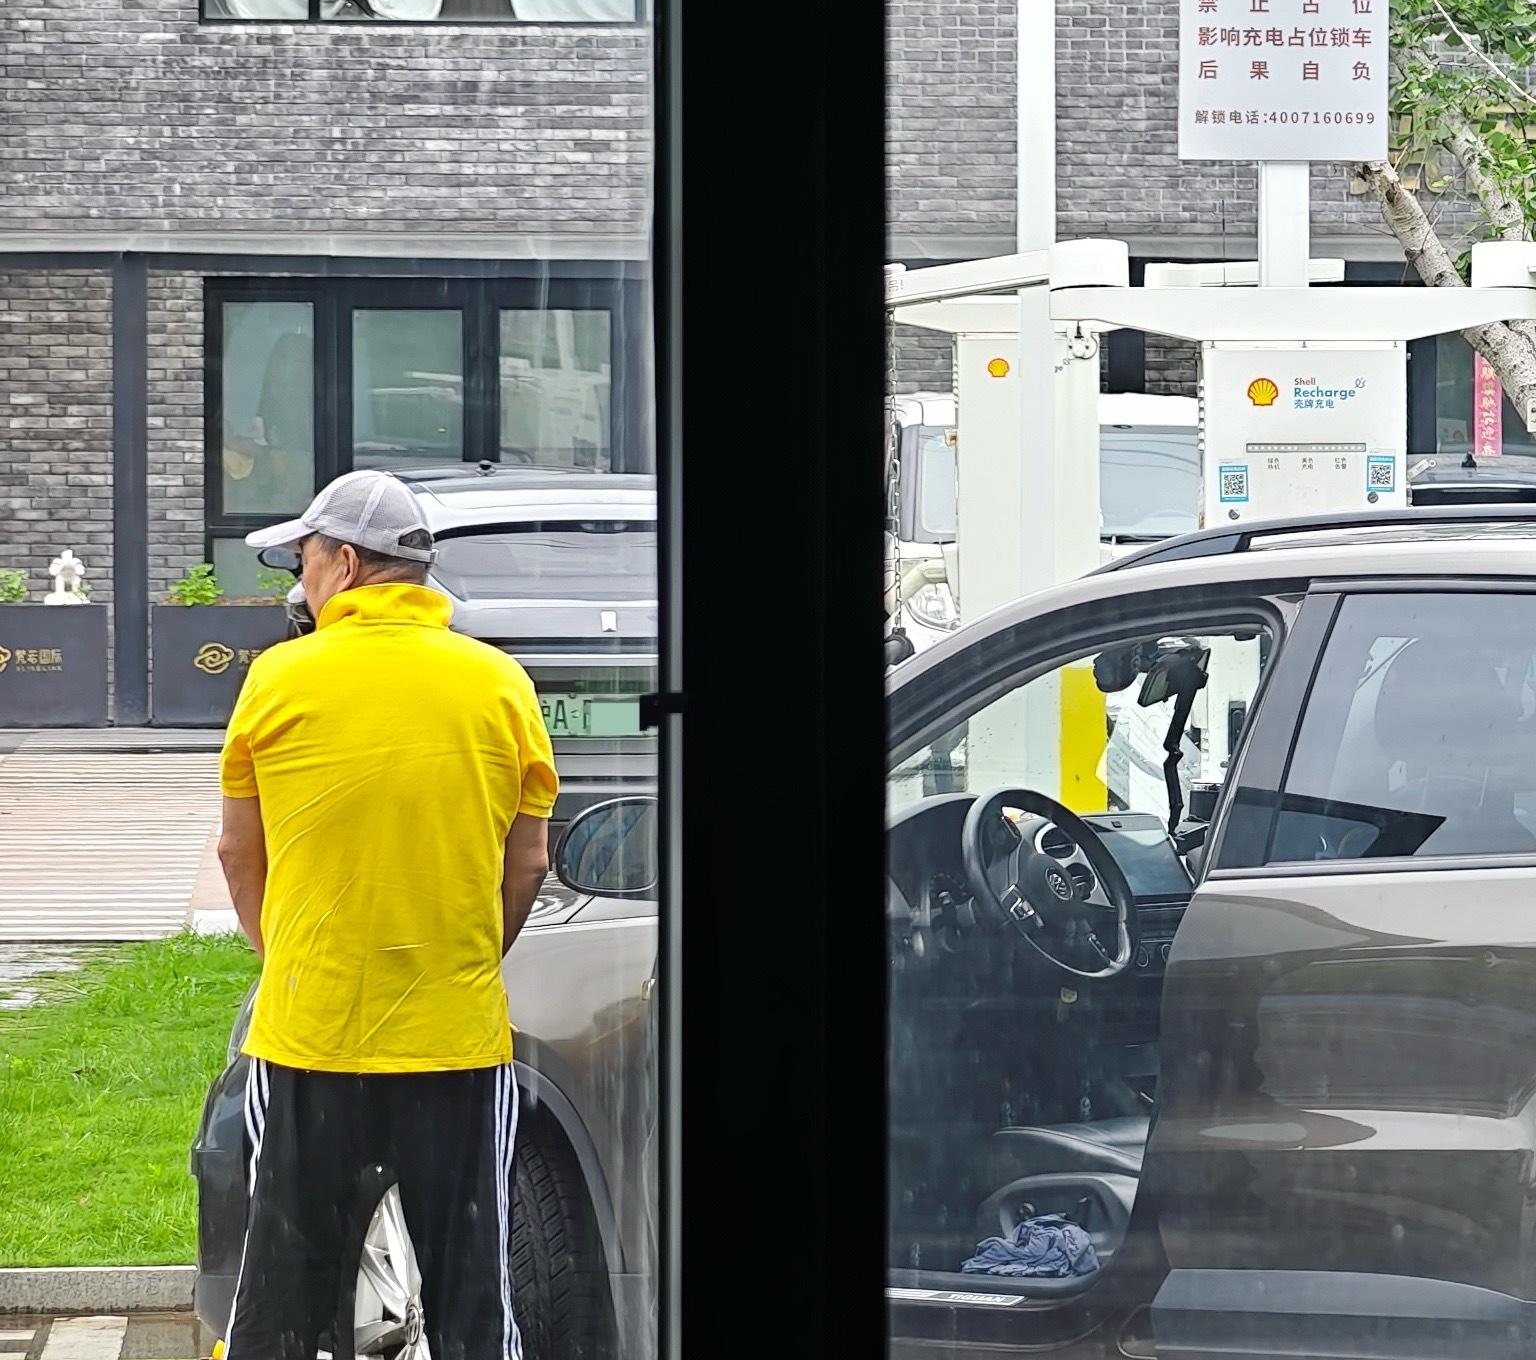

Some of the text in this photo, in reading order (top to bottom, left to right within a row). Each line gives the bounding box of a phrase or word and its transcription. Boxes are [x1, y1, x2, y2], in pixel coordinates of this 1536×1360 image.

[1198, 27, 1373, 48] 影响充电占位锁车
[1294, 377, 1316, 386] Shell
[1293, 387, 1356, 400] Recharge
[1294, 399, 1335, 409] 壳牌充电
